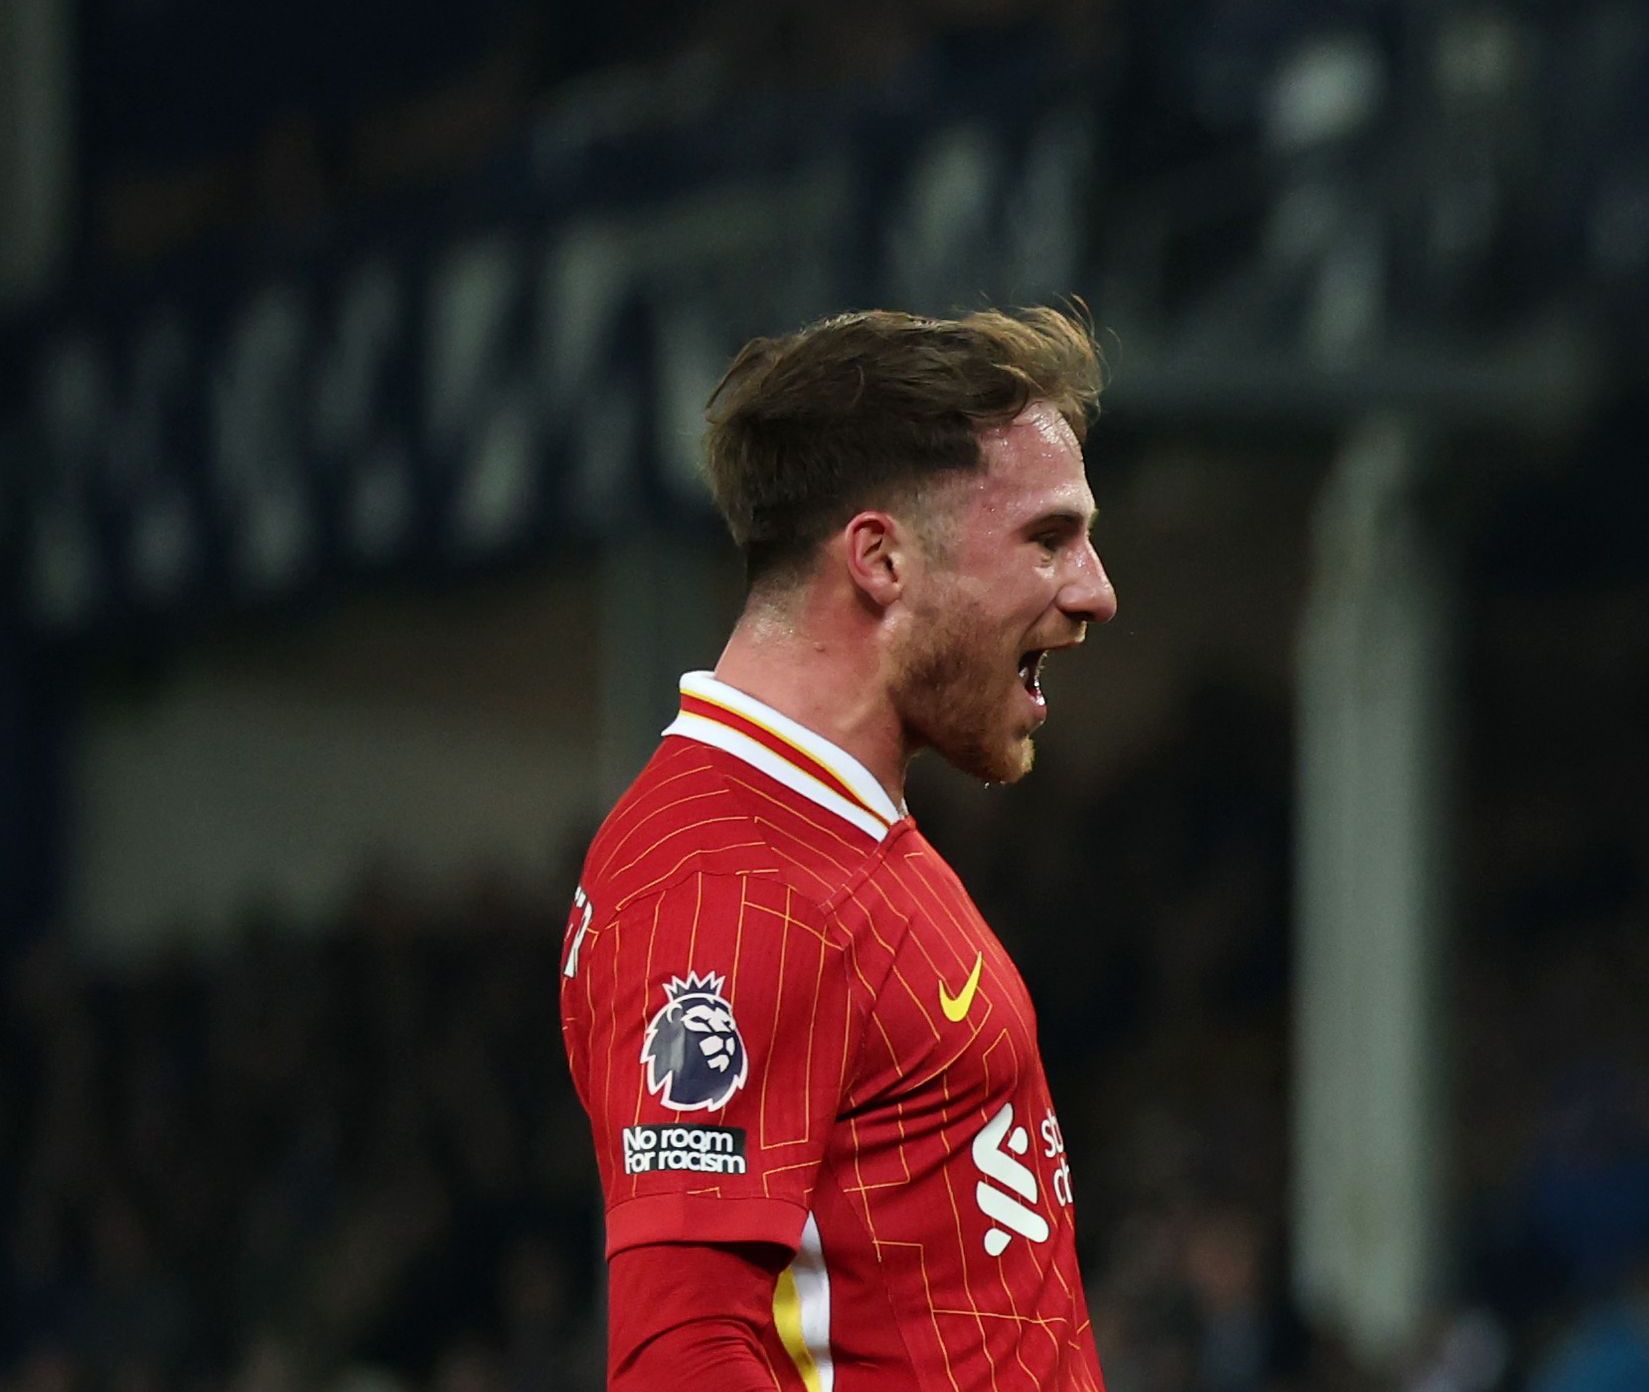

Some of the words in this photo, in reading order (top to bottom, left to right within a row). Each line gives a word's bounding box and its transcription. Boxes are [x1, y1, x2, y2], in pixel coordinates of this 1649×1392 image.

[622, 1127, 657, 1151] No
[661, 1128, 734, 1153] room
[624, 1150, 656, 1174] for
[658, 1150, 746, 1174] racism
